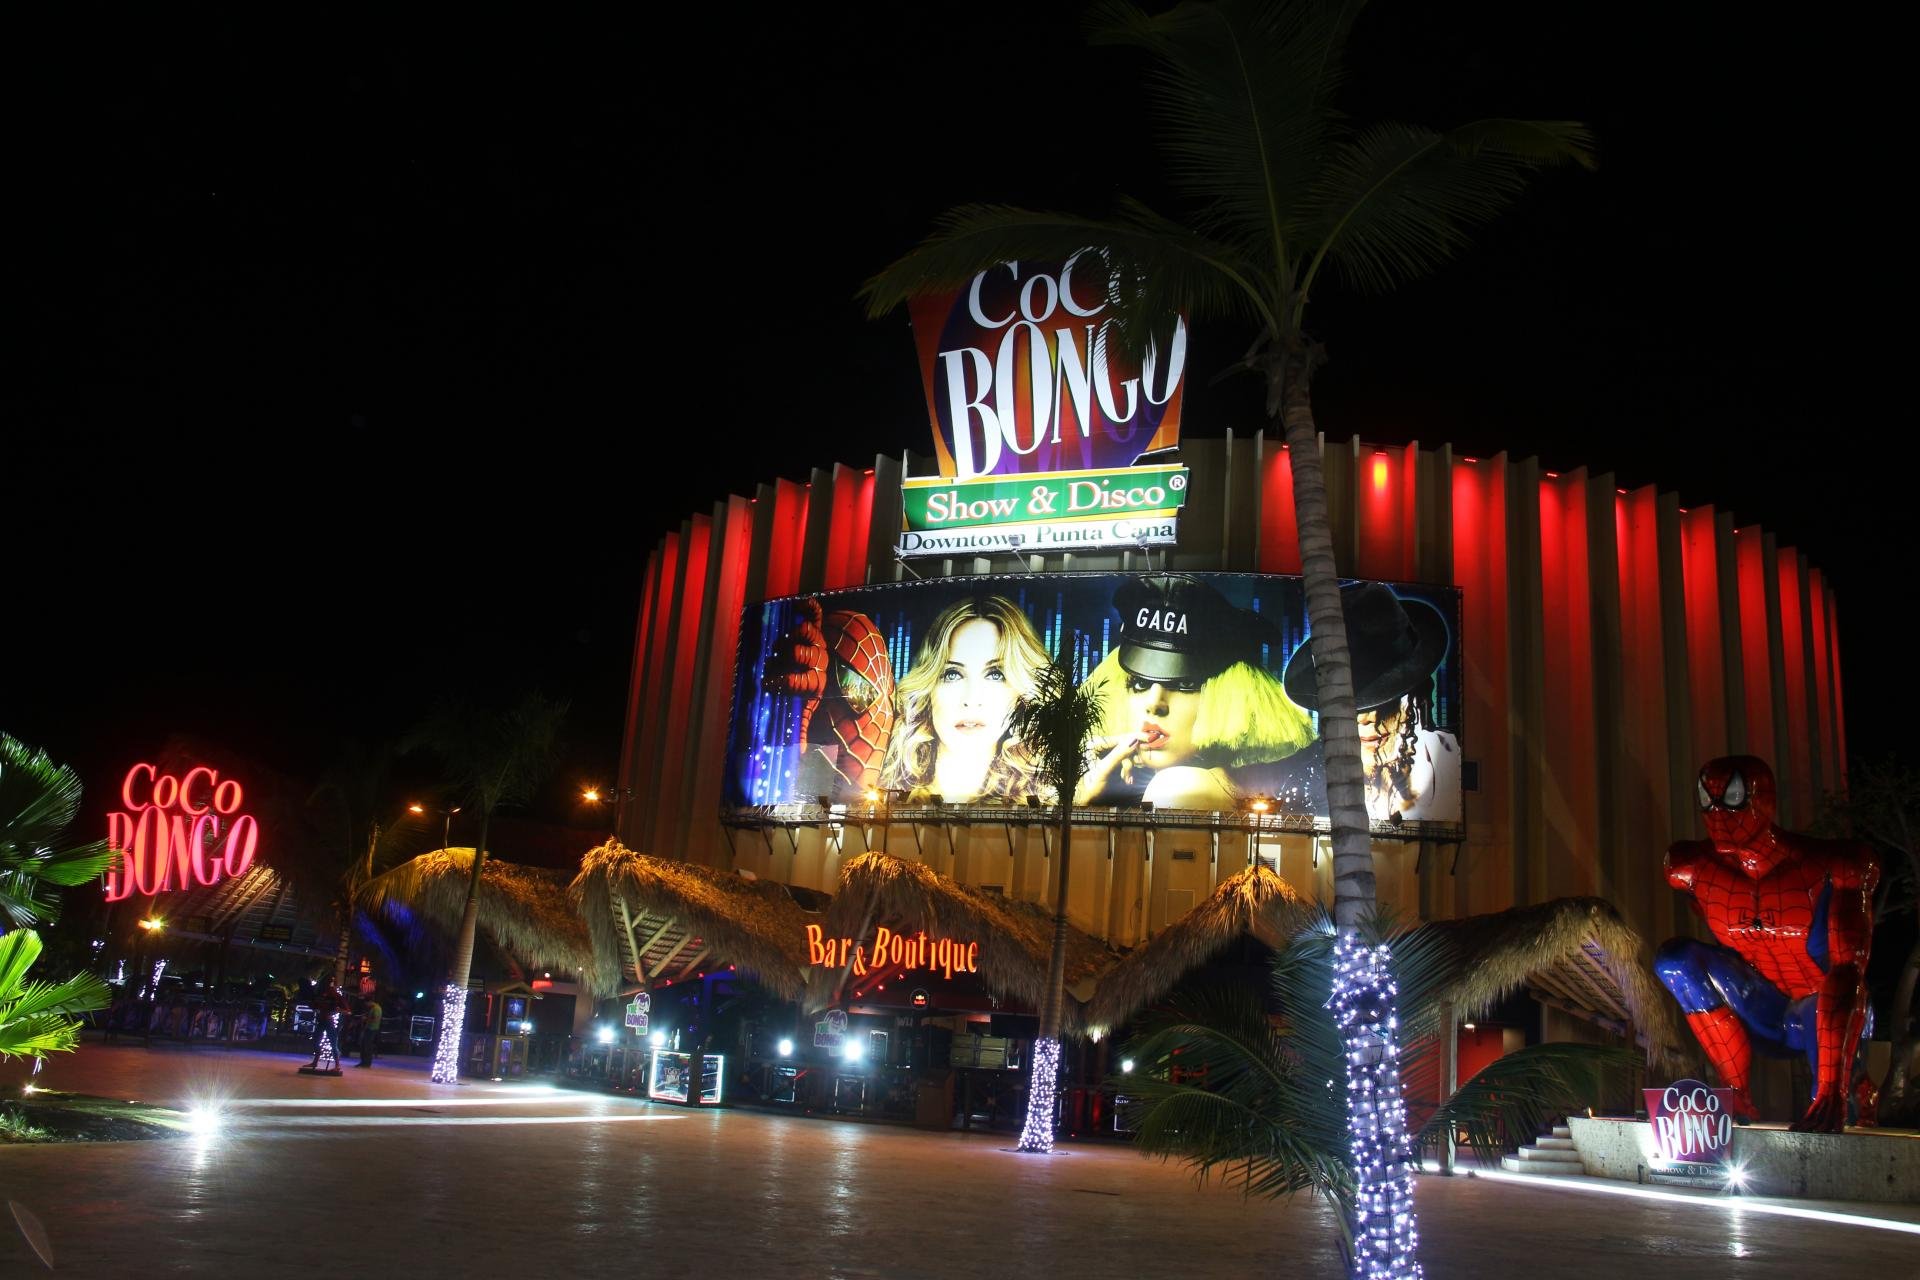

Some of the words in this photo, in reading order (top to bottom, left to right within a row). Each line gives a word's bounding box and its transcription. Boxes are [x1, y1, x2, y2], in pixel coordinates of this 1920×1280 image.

[938, 313, 1187, 483] BONGO
[926, 489, 1019, 524] Show
[1027, 485, 1060, 516] &
[1068, 479, 1166, 512] Disco
[1036, 525, 1103, 544] Punta
[1112, 521, 1175, 540] Cana
[1136, 607, 1188, 635] GAGA
[105, 805, 259, 903] BONGO
[805, 923, 852, 969] Bar
[853, 945, 867, 976] &
[870, 926, 978, 980] Boutique
[1655, 1110, 1732, 1161] BONGO
